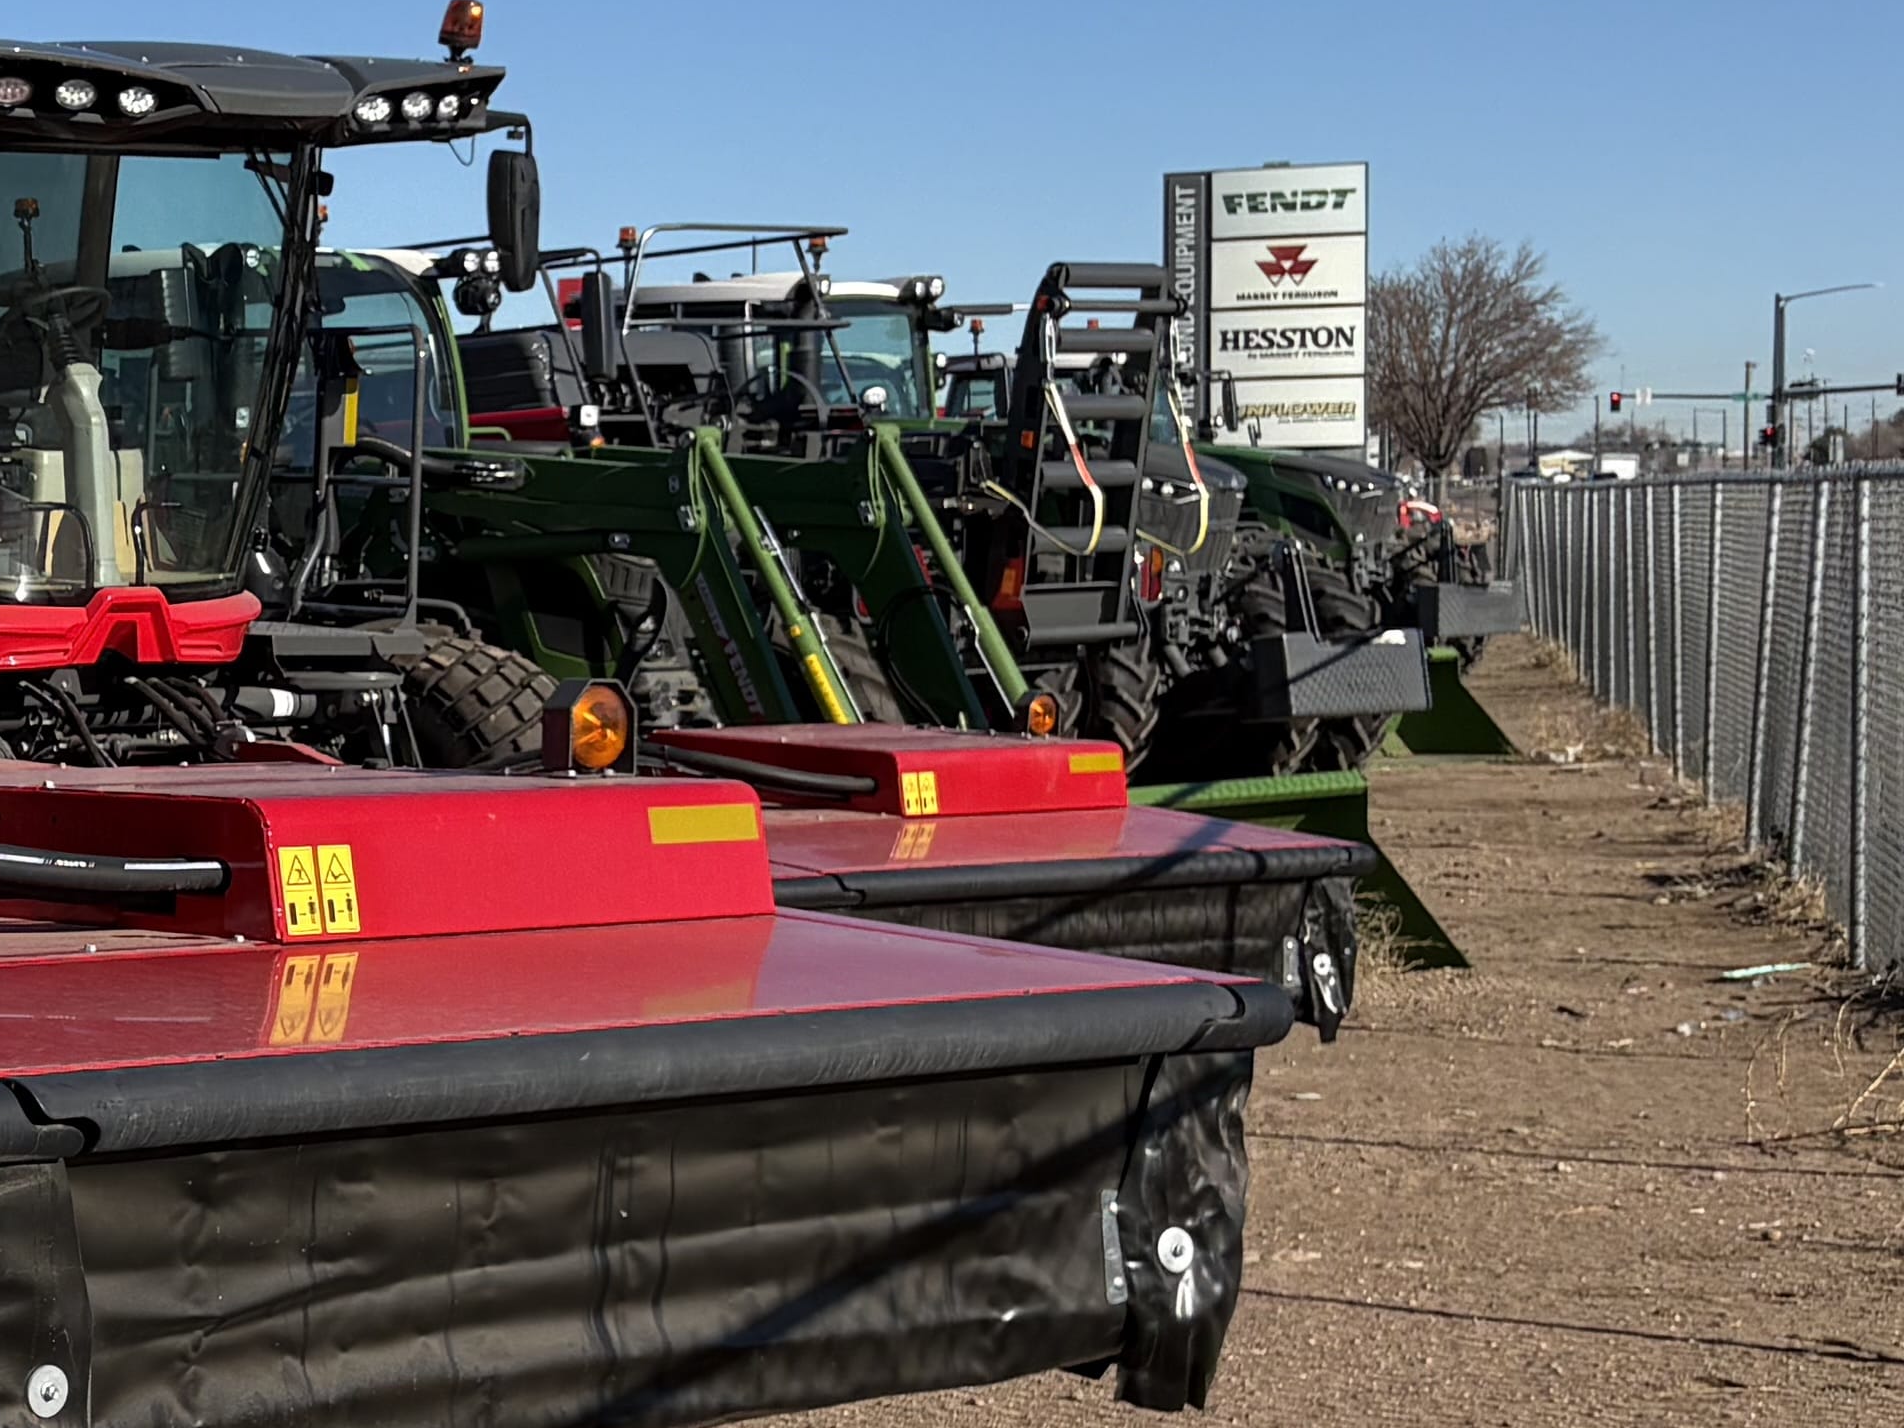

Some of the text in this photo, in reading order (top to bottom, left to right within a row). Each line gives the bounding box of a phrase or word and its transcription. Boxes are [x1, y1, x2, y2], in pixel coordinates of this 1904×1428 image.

[1221, 187, 1358, 216] FENDT
[1235, 288, 1339, 301] MASSEY FERGUSON
[1219, 324, 1357, 352] HESSTON
[1238, 402, 1357, 420] UNFLOWER
